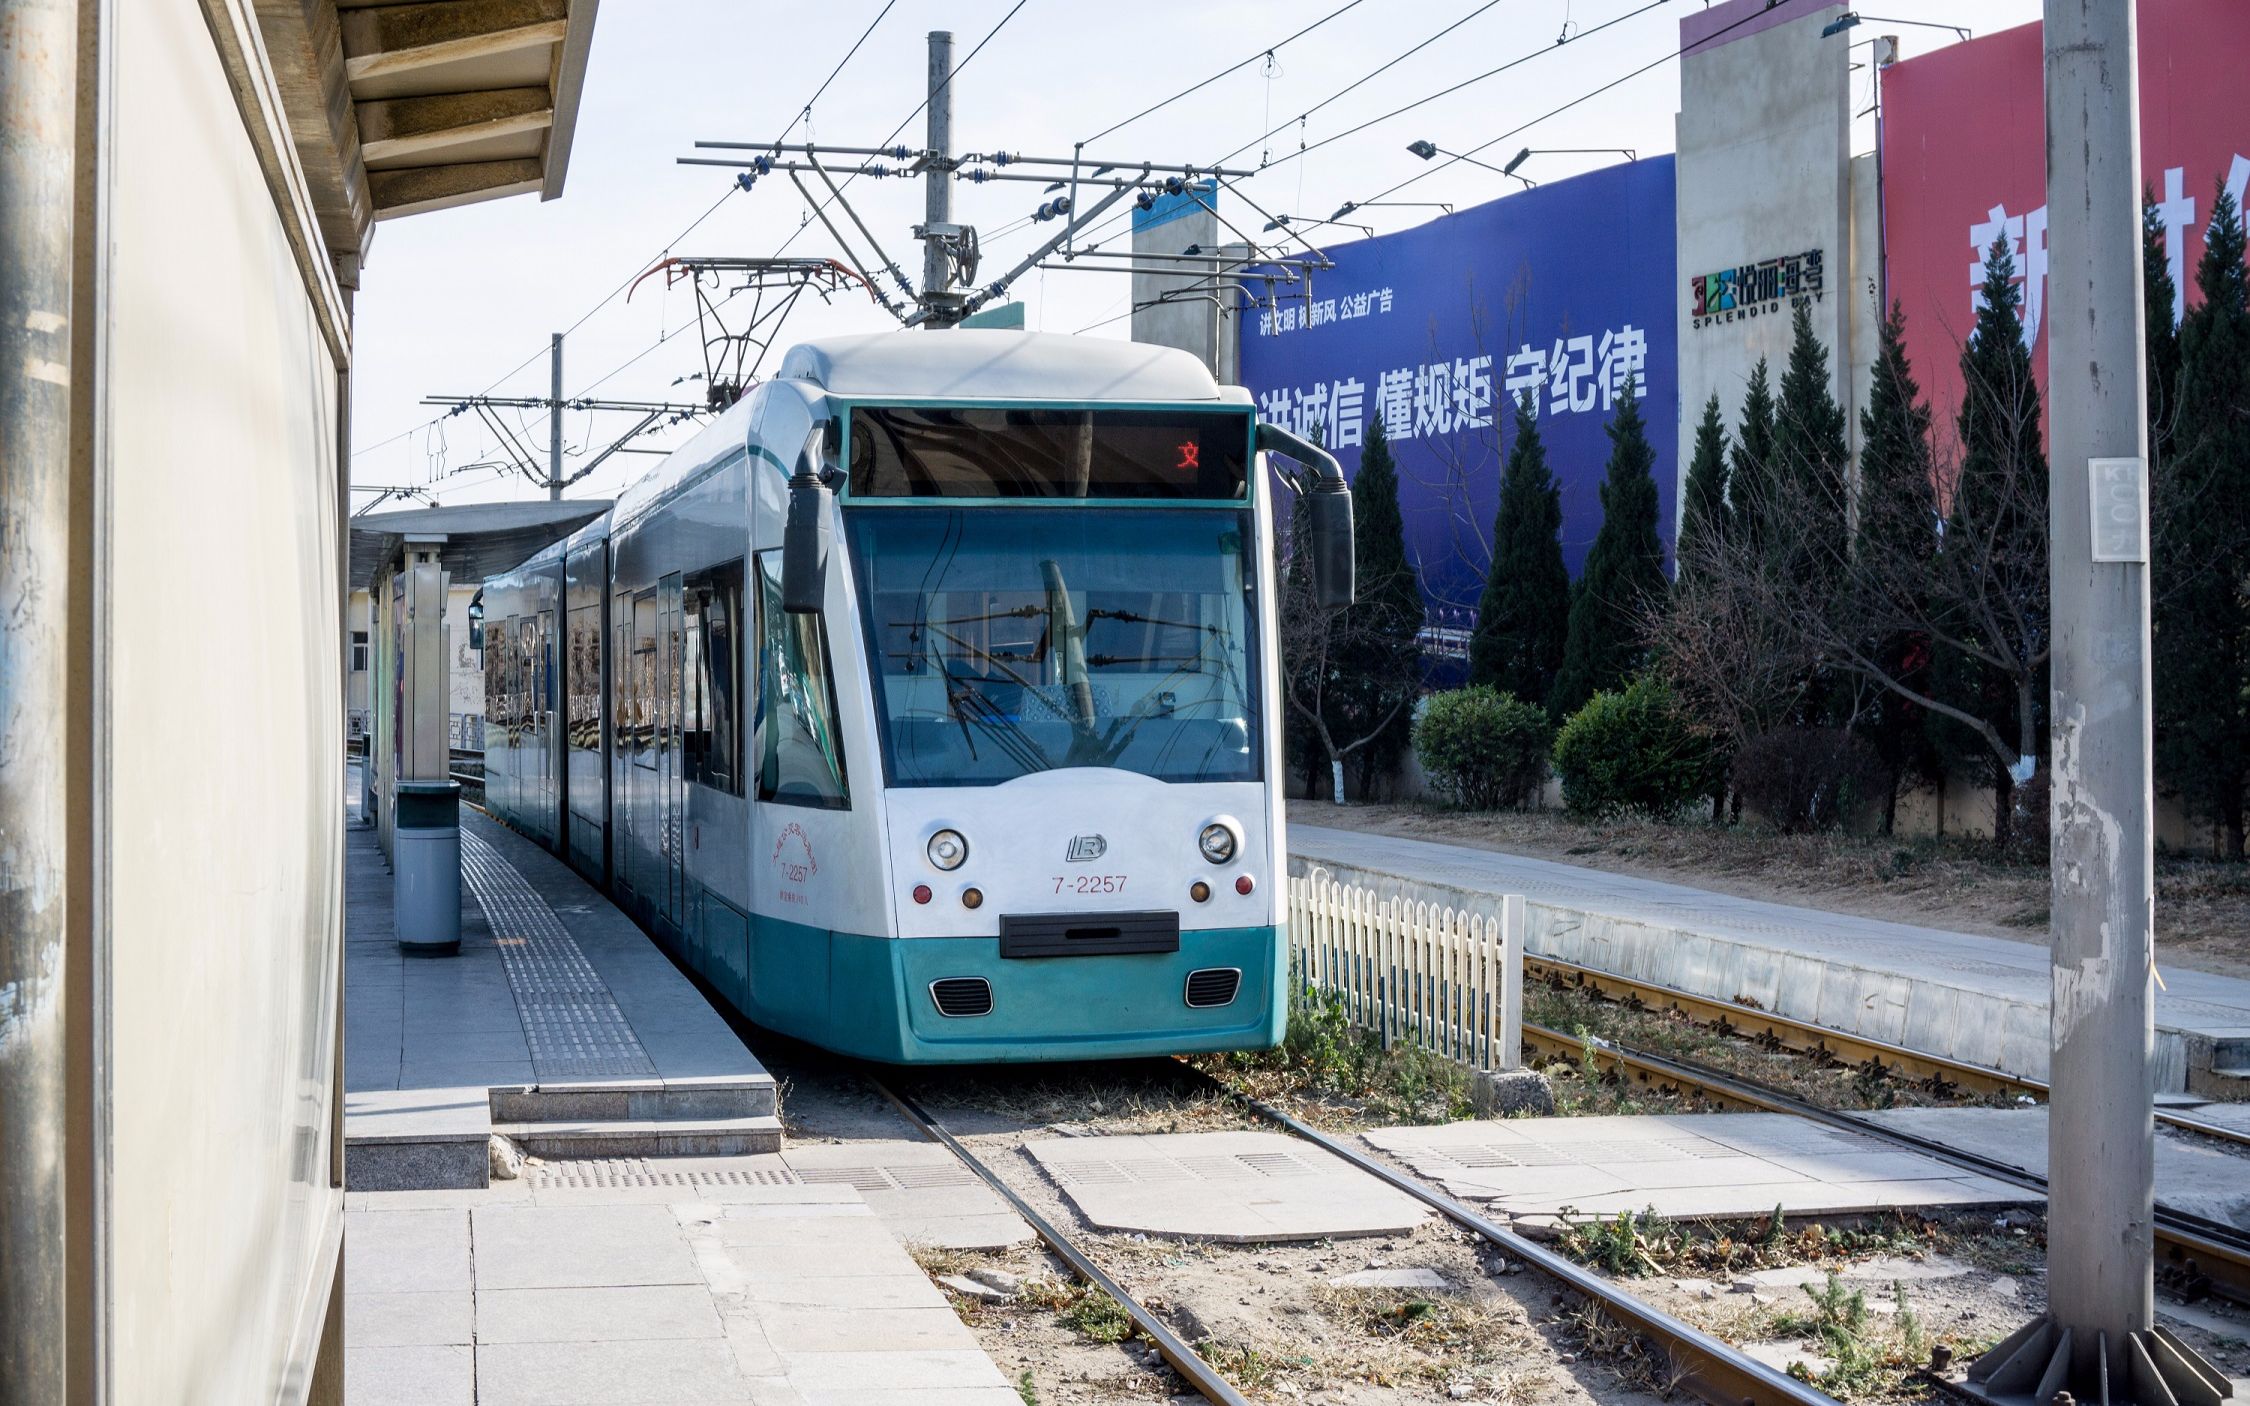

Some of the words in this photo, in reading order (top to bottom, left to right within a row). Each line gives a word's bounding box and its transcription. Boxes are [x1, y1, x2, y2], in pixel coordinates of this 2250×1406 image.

[1340, 287, 1393, 320] 公益广告
[1693, 302, 1779, 330] SPLENDID
[1792, 292, 1823, 309] BAY
[1376, 355, 1493, 441] 懂规矩
[1505, 325, 1648, 416] 守纪律
[781, 862, 808, 884] 7-2257
[1052, 875, 1127, 894] 7-2257
